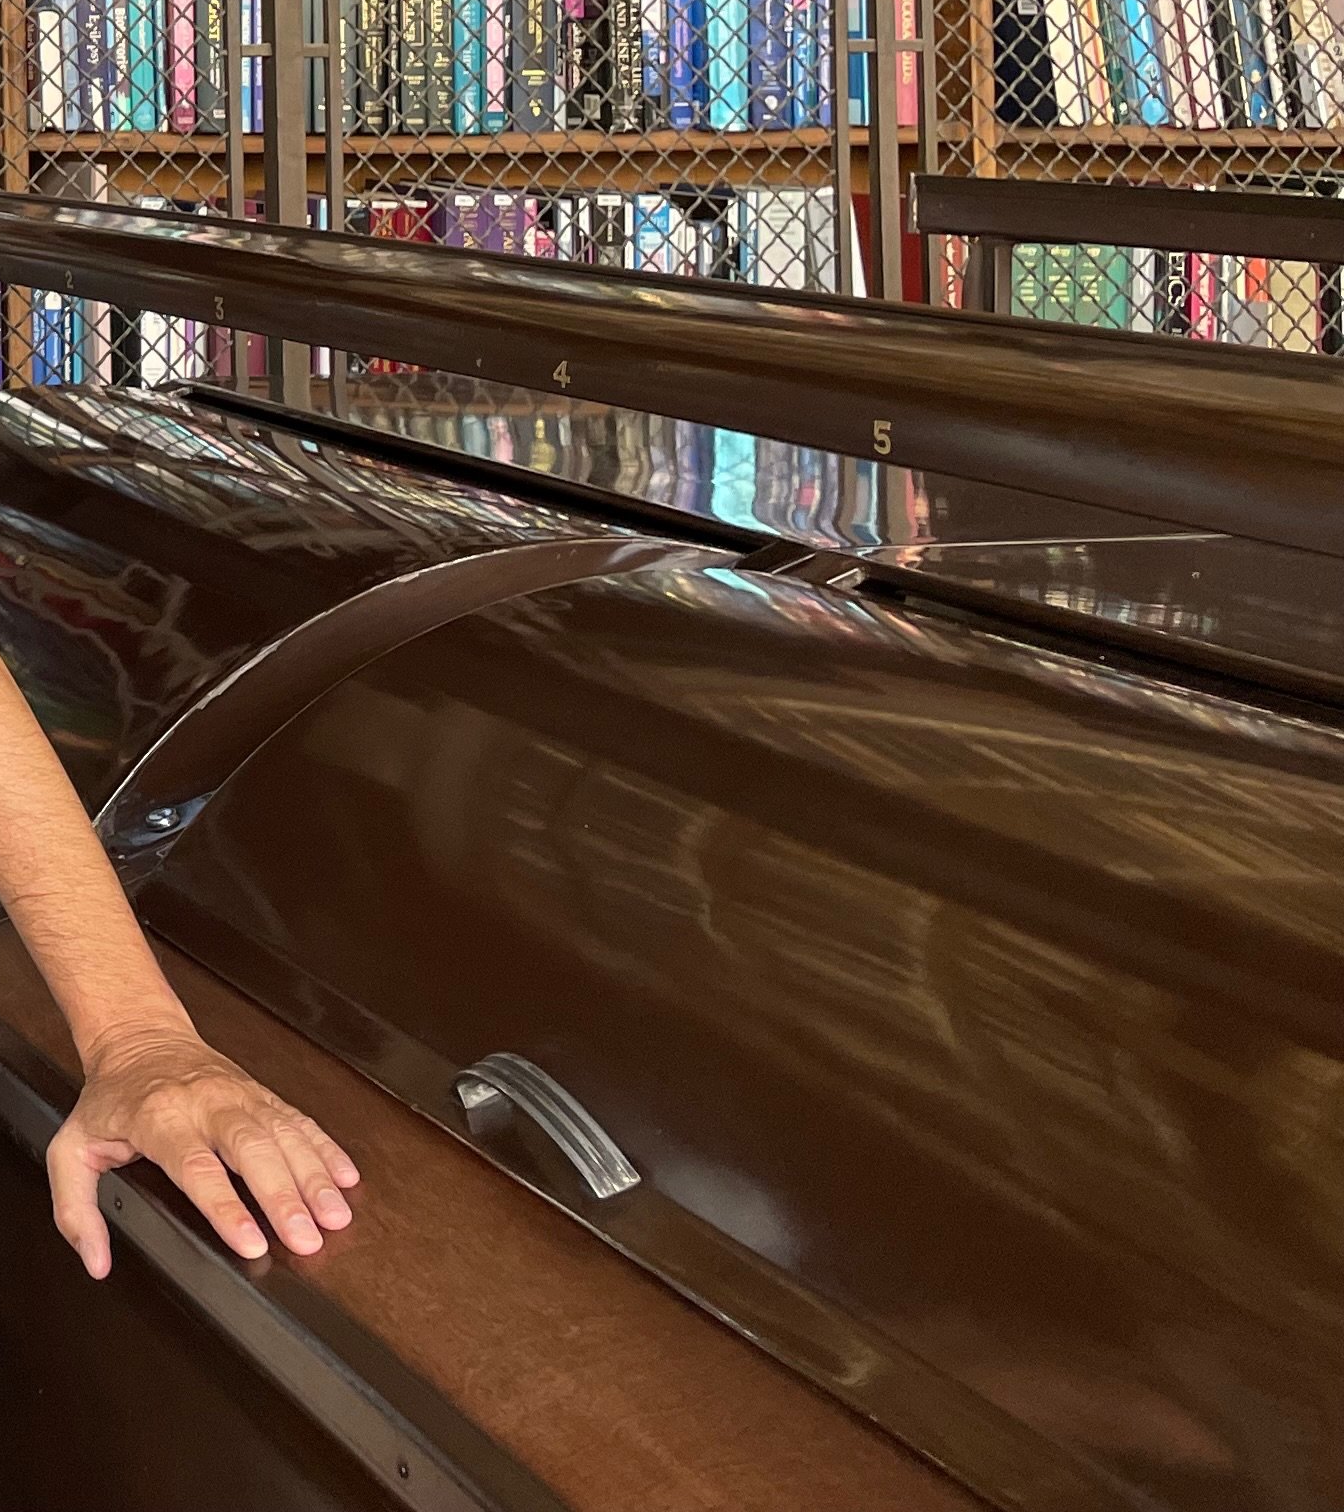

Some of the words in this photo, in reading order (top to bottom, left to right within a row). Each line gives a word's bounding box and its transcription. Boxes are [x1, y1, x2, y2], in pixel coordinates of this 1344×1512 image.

[65, 269, 75, 289] 2
[214, 296, 225, 321] 3
[552, 359, 572, 390] 4
[872, 419, 893, 455] 5
